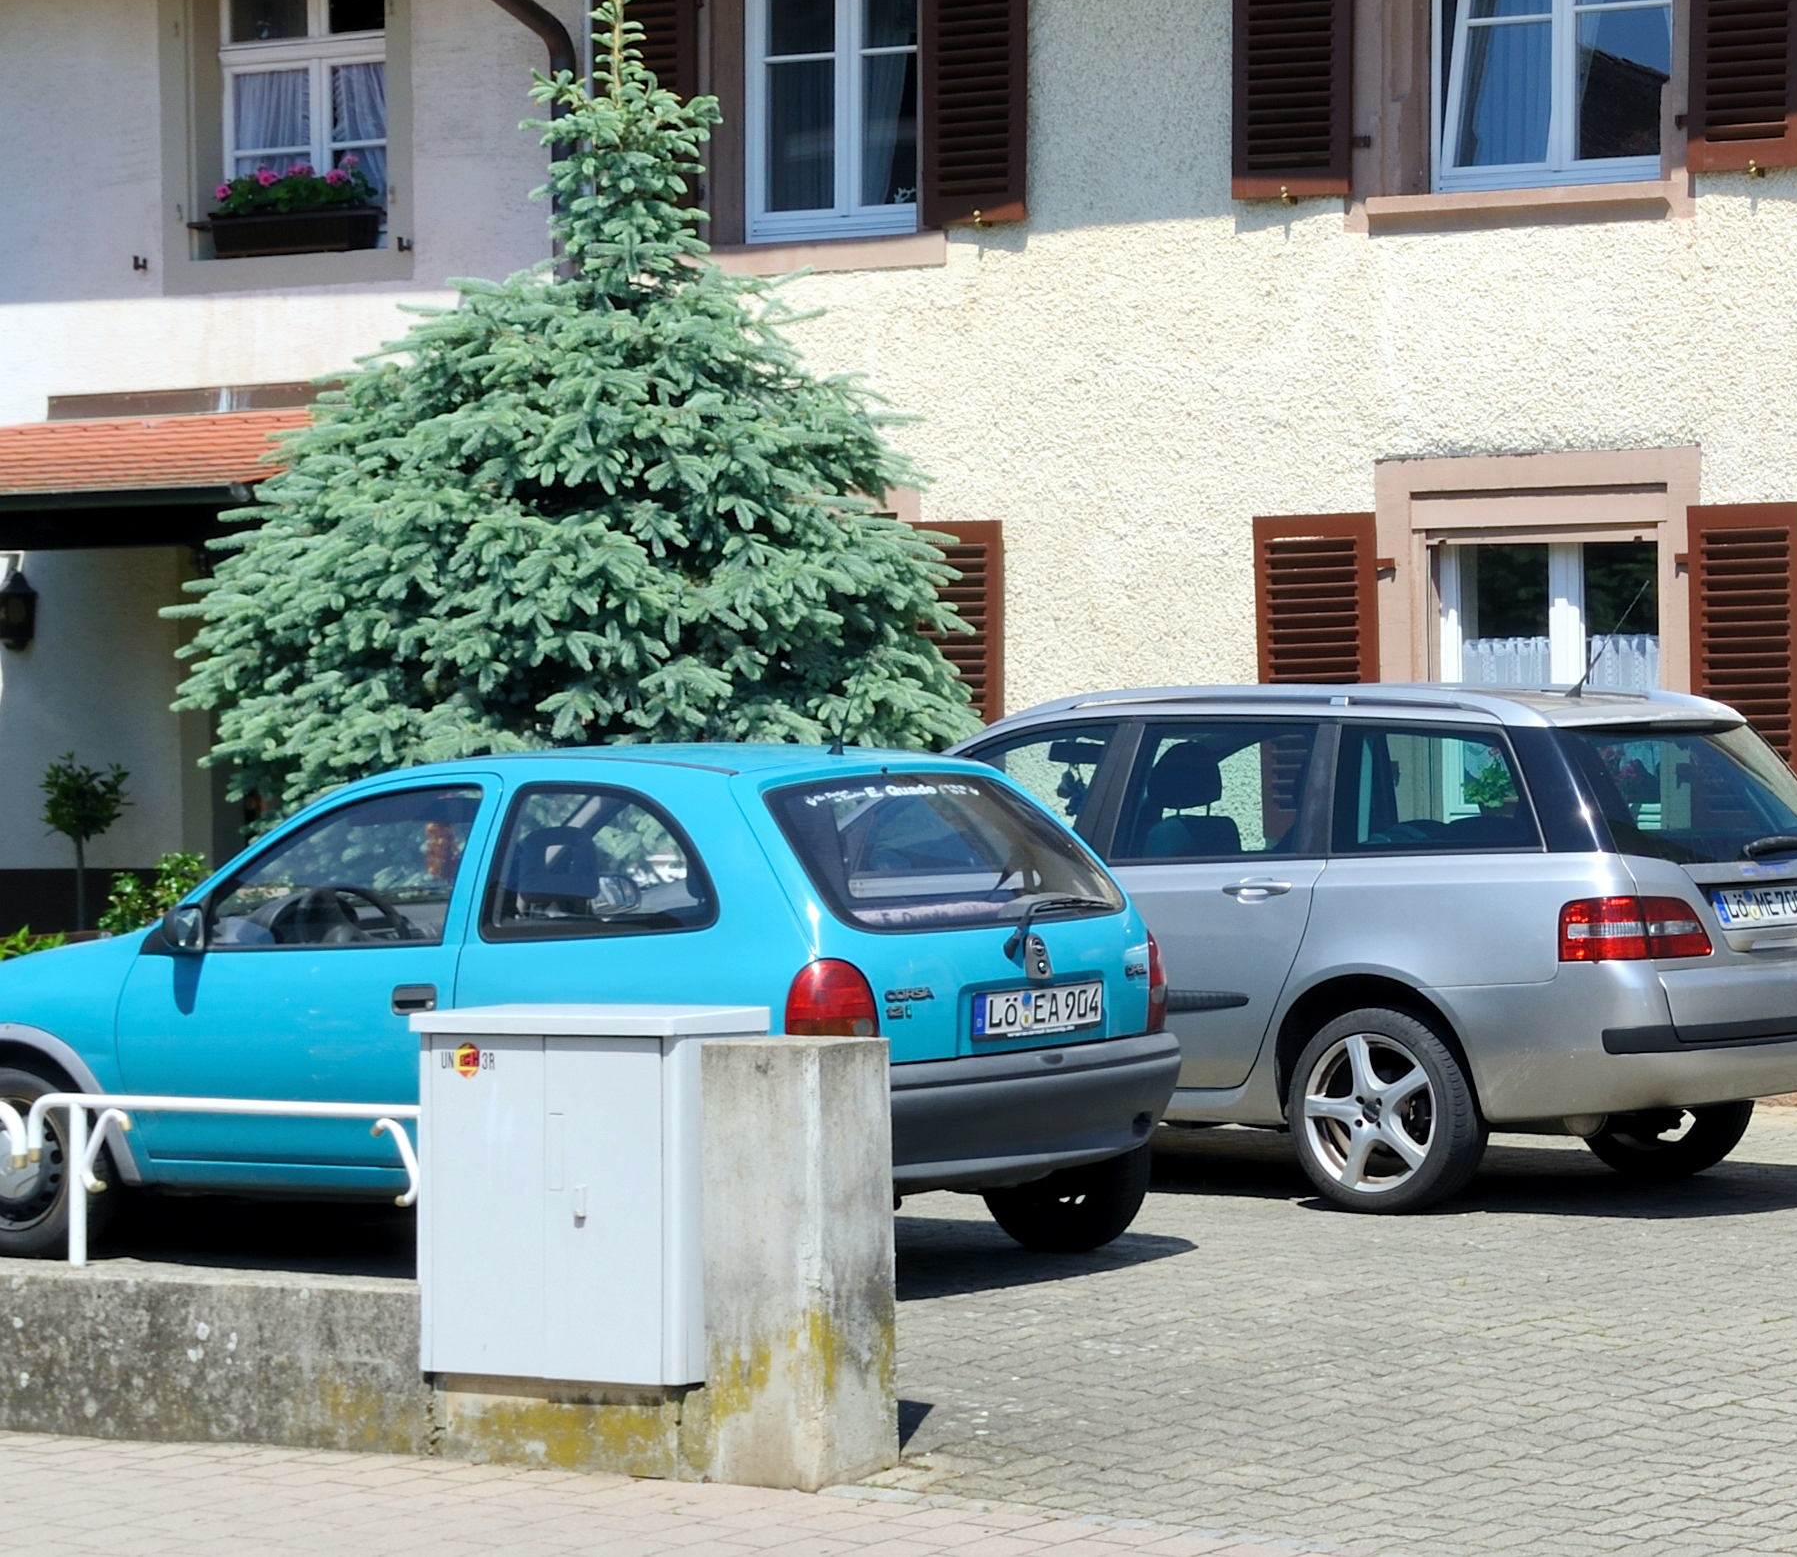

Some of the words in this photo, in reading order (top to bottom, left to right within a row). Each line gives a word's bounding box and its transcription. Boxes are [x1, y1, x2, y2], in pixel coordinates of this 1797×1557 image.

[1723, 893, 1749, 919] LÖ
[1754, 892, 1778, 917] ME
[885, 987, 935, 1003] CORSA
[988, 996, 1019, 1028] LÖ
[1033, 992, 1060, 1024] EA
[1064, 987, 1099, 1021] 904
